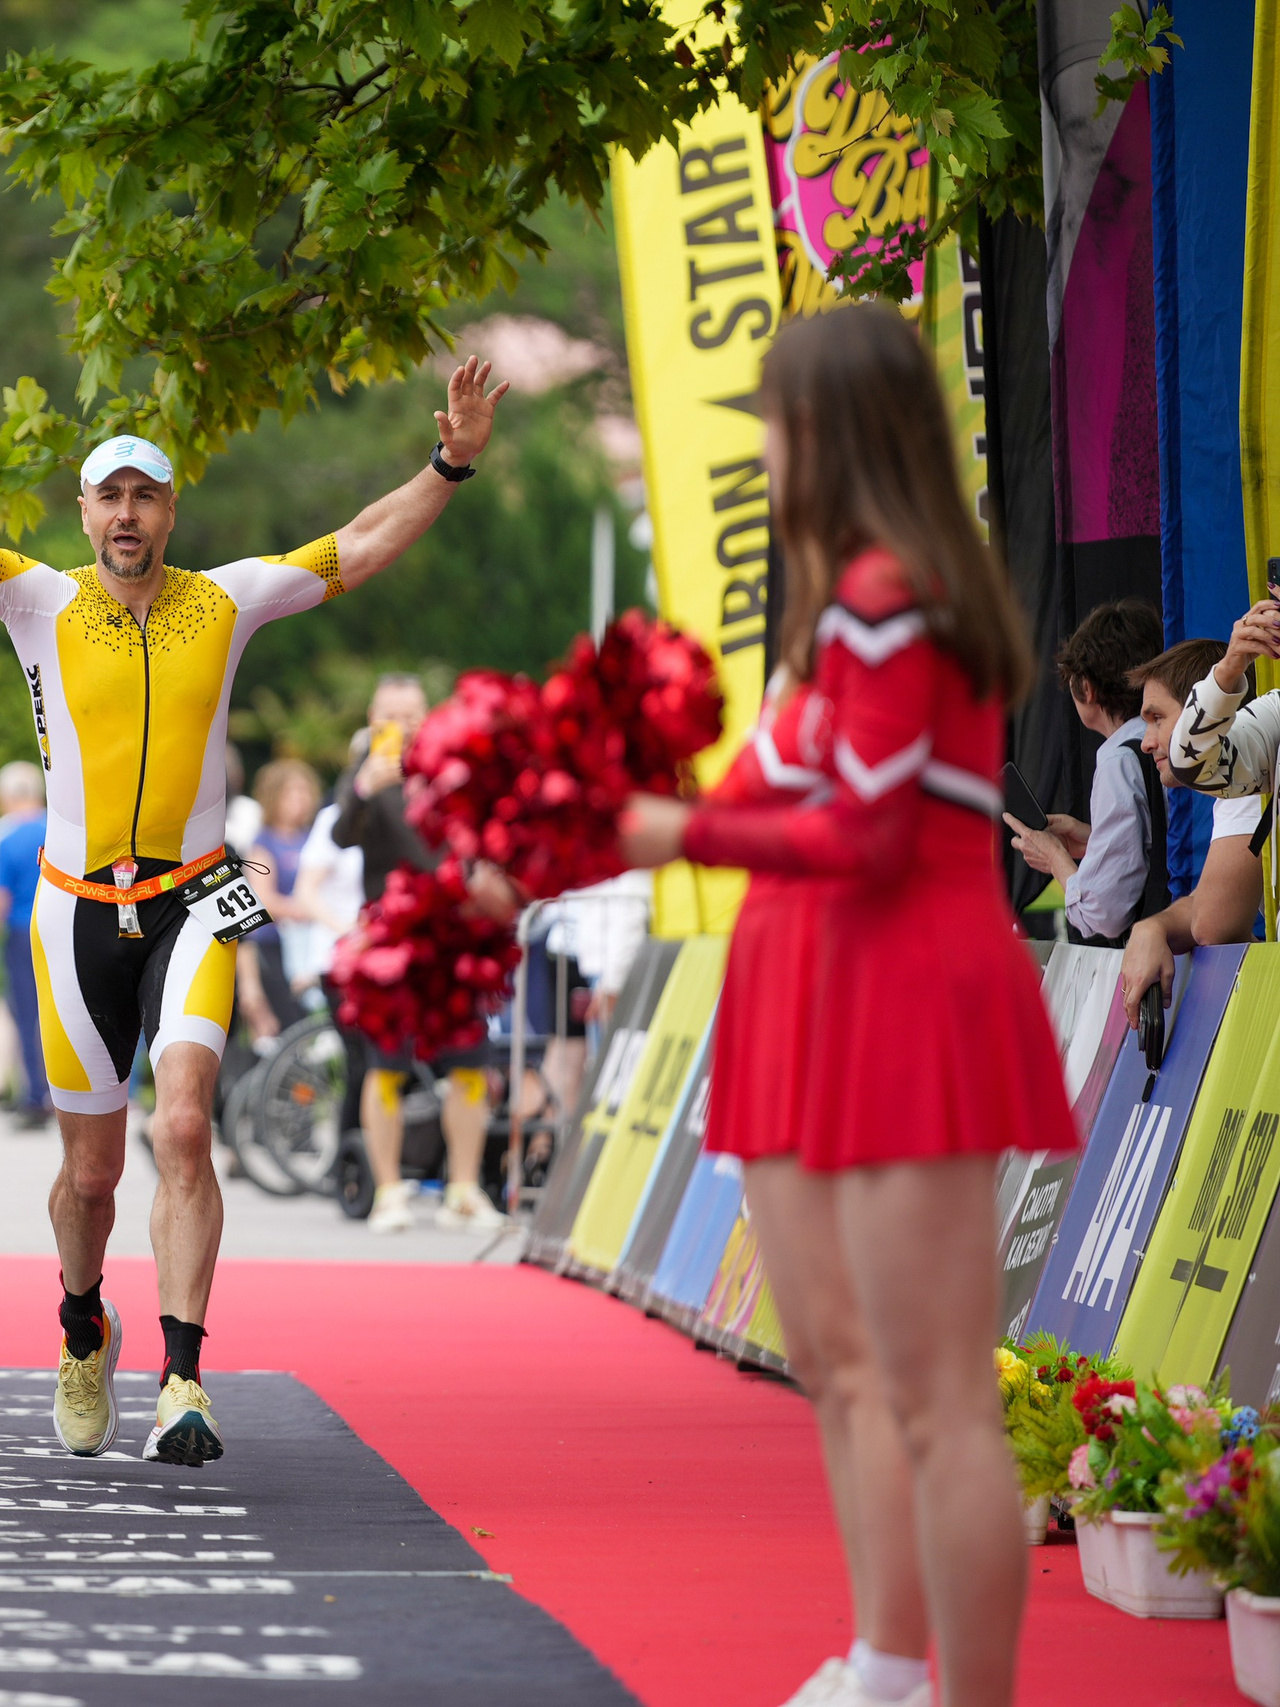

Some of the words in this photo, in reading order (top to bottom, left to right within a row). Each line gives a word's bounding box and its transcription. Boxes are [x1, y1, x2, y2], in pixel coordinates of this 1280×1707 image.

[679, 136, 772, 353] STAR
[216, 883, 257, 918] 413
[239, 913, 264, 931] ALEKSEI
[1216, 1109, 1280, 1240] STAR
